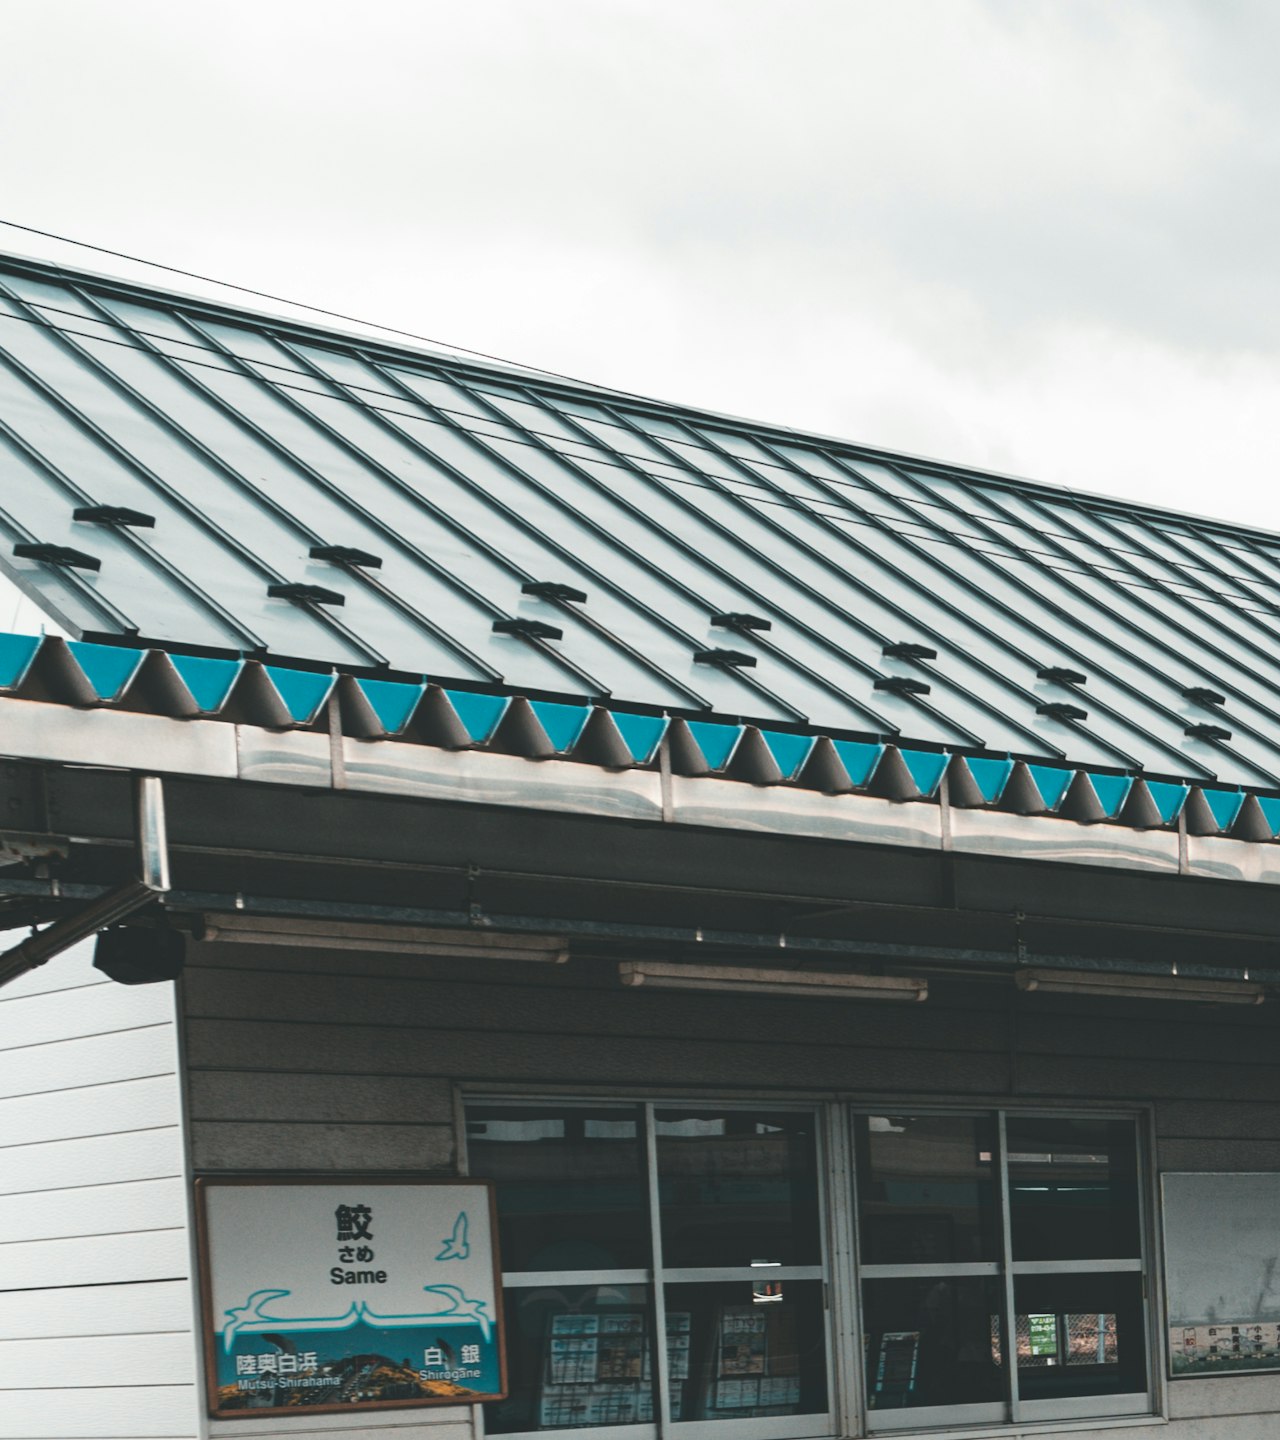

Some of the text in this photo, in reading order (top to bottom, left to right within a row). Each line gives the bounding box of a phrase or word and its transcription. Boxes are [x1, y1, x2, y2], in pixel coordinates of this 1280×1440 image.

[334, 1203, 374, 1242] 鮫
[338, 1246, 374, 1263] さめ
[331, 1267, 387, 1284] Same
[235, 1351, 319, 1376] 陸奥白浜
[423, 1344, 481, 1367] 白銀
[237, 1374, 341, 1391] Mutsu-Shirahama
[419, 1367, 482, 1382] Shirogane
